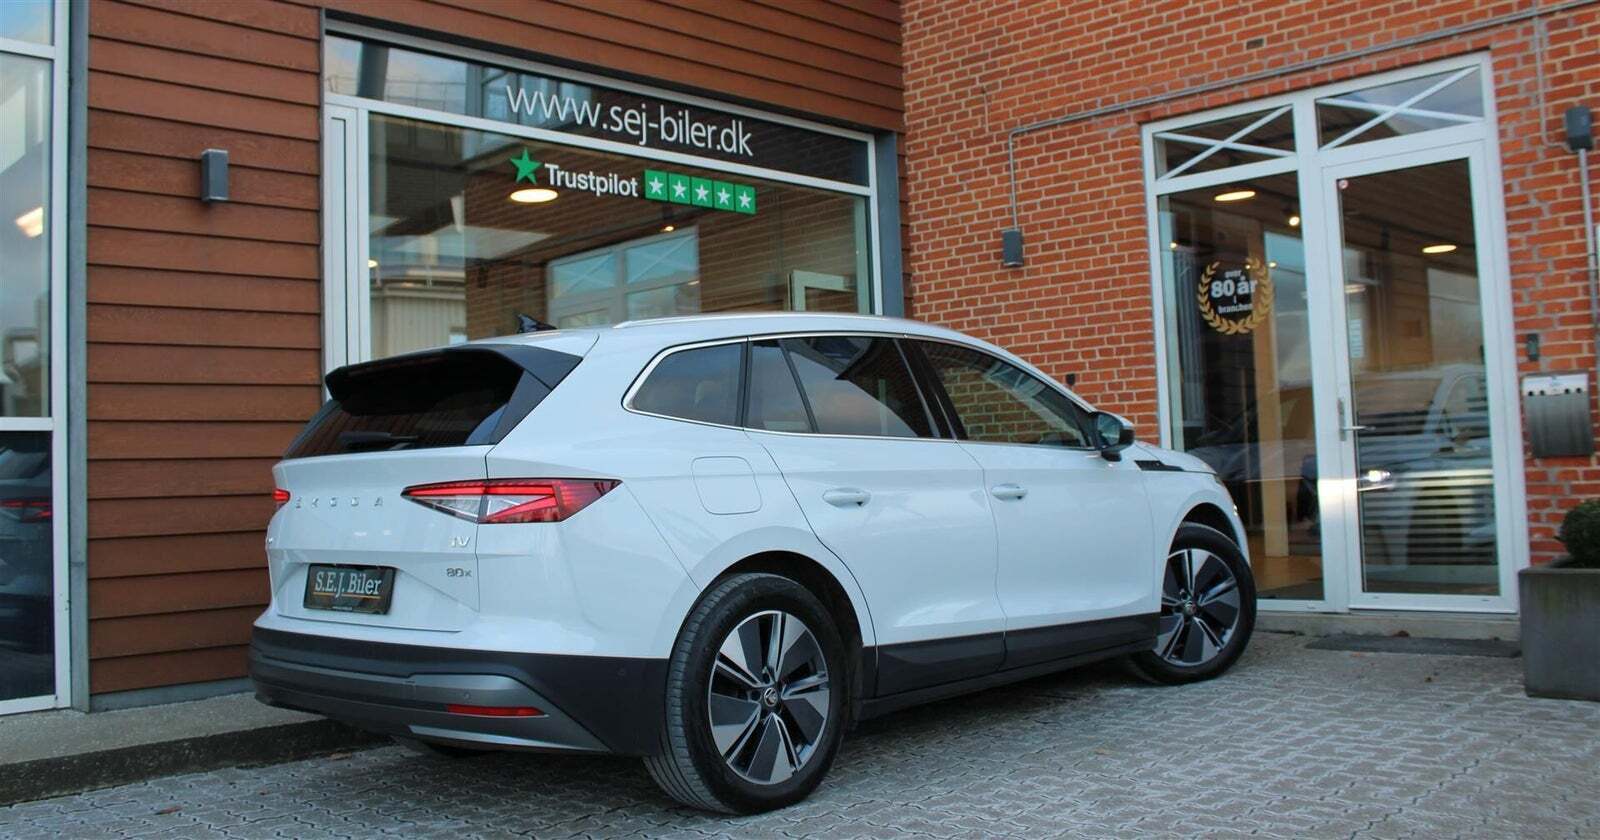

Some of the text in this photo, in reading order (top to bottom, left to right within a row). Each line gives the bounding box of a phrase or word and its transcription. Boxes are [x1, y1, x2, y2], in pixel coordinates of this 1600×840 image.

[506, 85, 754, 157] www.sej-biler.dk
[544, 162, 639, 198] Trustpilot
[1210, 275, 1258, 298] 80 år
[315, 571, 381, 598] S.E.J. Biler
